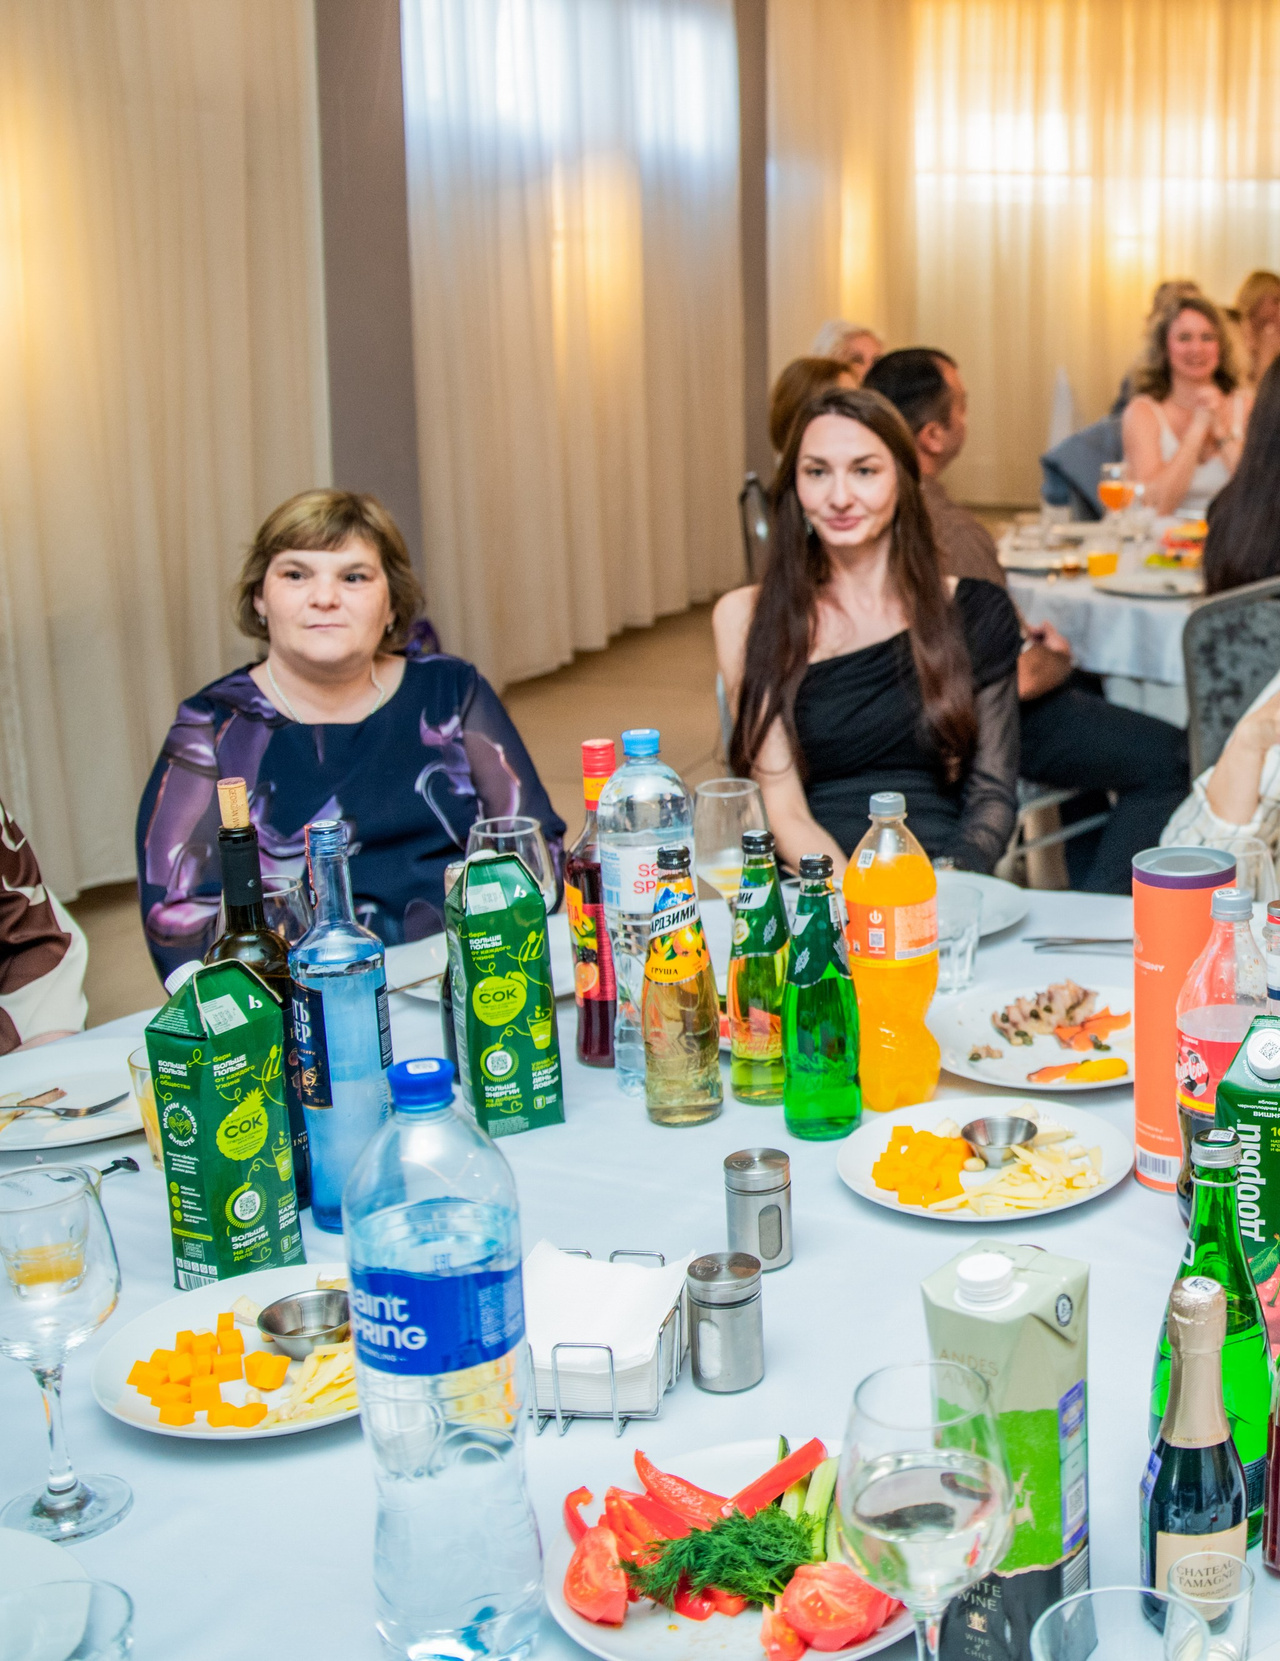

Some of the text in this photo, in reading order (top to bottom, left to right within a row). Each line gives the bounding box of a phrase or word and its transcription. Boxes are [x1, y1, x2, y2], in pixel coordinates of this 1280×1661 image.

[633, 880, 657, 894] SP
[469, 934, 502, 945] БОЛЬШЕ
[470, 940, 502, 951] ПОЛЬЗЫ
[651, 967, 678, 975] ГРУША
[479, 987, 518, 1004] СОК
[292, 997, 310, 1022] ТЬ
[294, 1020, 312, 1044] ЕР
[158, 1060, 187, 1070] БОЛЬШЕ
[212, 1052, 232, 1063] бери
[213, 1054, 247, 1071] БОЛЬШЕ
[158, 1066, 188, 1077] ПОЛЬЗЫ
[213, 1061, 247, 1077] ПОЛЬЗЫ
[485, 1082, 517, 1092] БОЛЬШЕ
[485, 1088, 520, 1098] ЭНЕРГИИ
[162, 1102, 198, 1147] РАСТИМ ДОБРО ВМЕСТЕ
[224, 1113, 264, 1138] СОК
[231, 1225, 266, 1243] БОЛЬШЕ
[232, 1231, 269, 1250] ЭНЕРГИИ
[970, 1581, 1002, 1598] ITE
[964, 1633, 991, 1647] WINE
